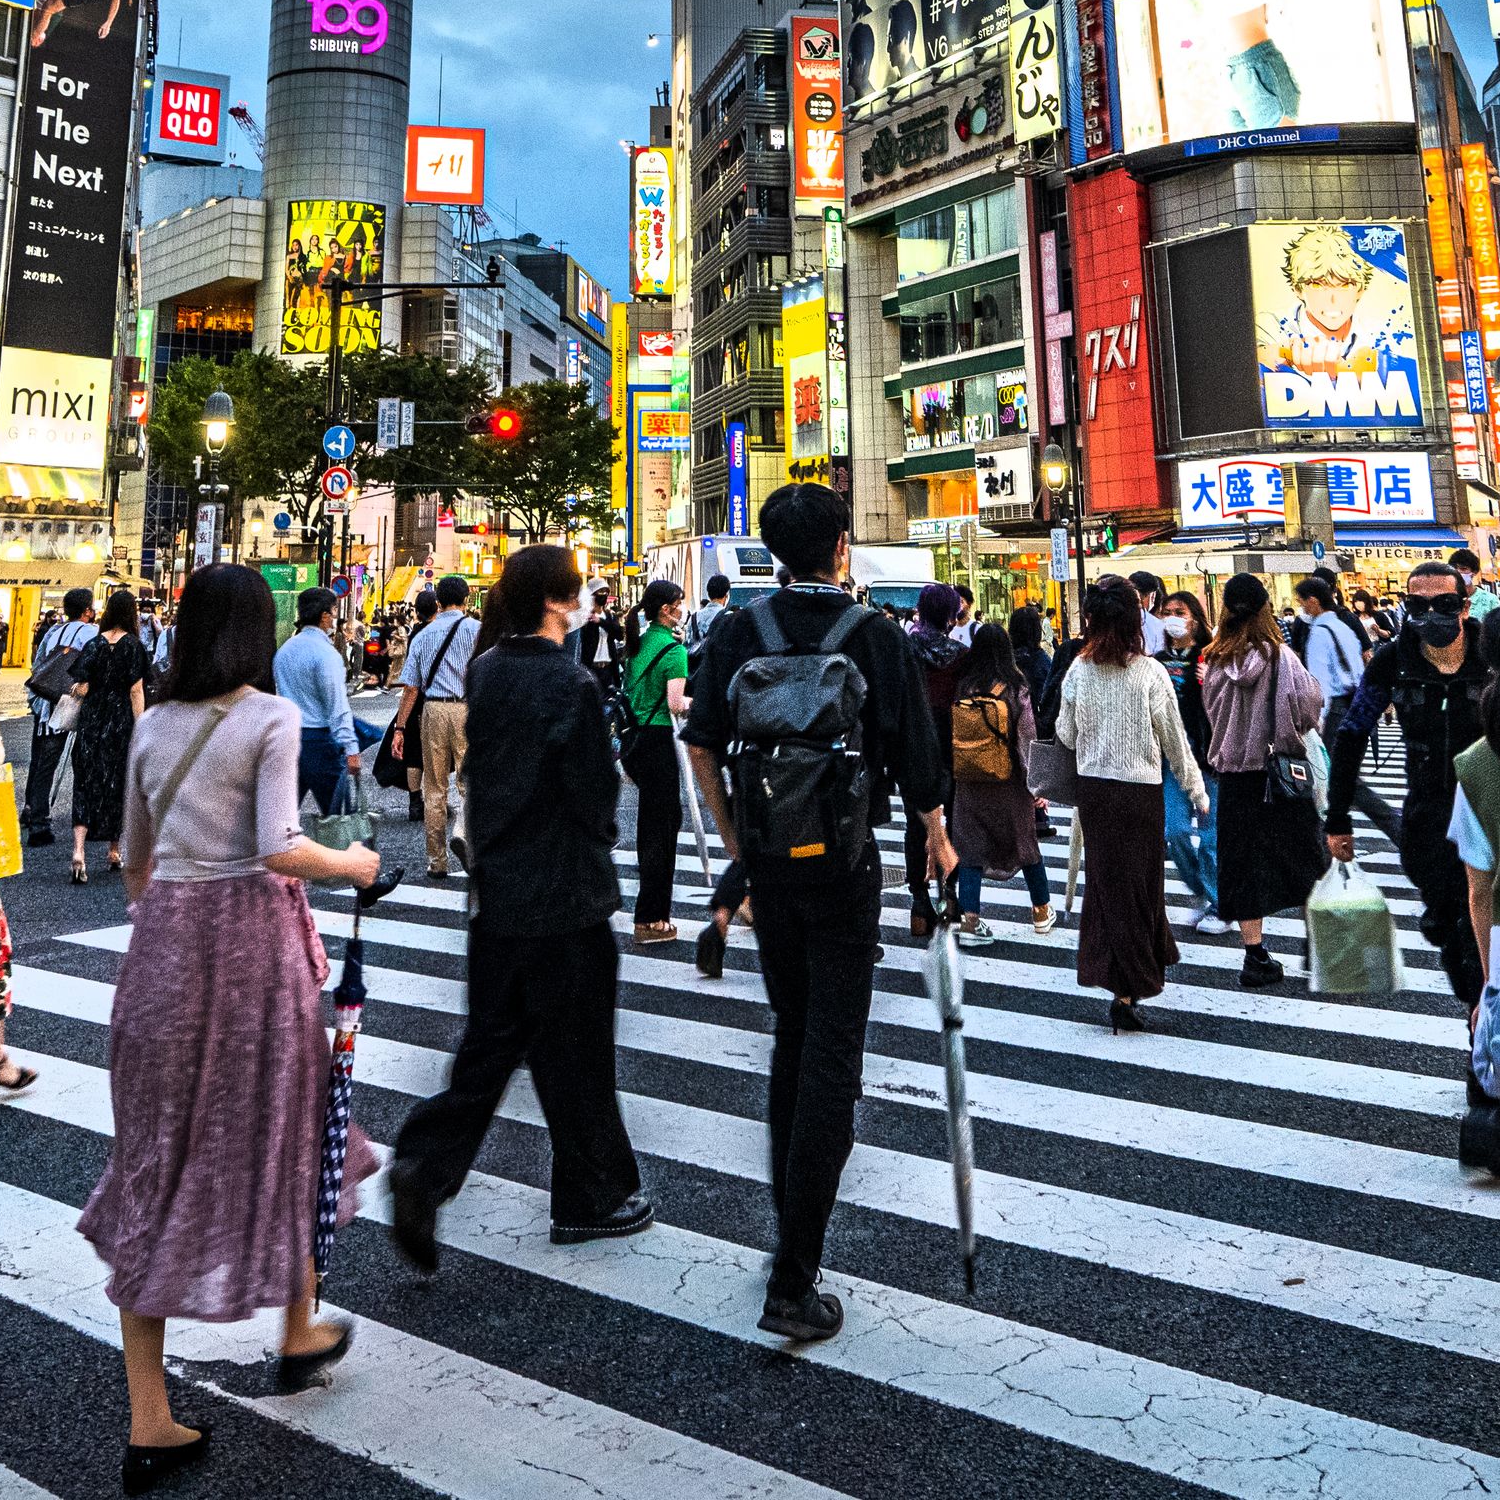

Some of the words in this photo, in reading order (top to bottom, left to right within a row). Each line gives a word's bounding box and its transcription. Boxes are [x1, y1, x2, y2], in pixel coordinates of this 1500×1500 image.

[310, 38, 359, 54] SHIBUYA
[927, 35, 949, 61] V6
[40, 63, 90, 100] For
[168, 88, 210, 115] UNI
[36, 106, 90, 145] The
[167, 112, 213, 138] QLO
[1217, 135, 1246, 149] DHC
[1247, 130, 1300, 146] Channel
[33, 149, 108, 194] Next.
[30, 196, 54, 209] 新たな
[28, 220, 105, 244] コミュニケーションを
[22, 270, 63, 285] 次の世界へ
[283, 307, 381, 329] COMING
[282, 325, 381, 354] SOON
[1085, 295, 1141, 420] クスリ
[1464, 335, 1484, 413] 大盛堂商事ビル
[11, 378, 95, 421] mixi
[1264, 371, 1418, 418] DMM
[8, 426, 92, 443] GROUP
[647, 413, 671, 434] 薬
[964, 413, 994, 442] RE/D
[733, 430, 742, 468] MIZUHO
